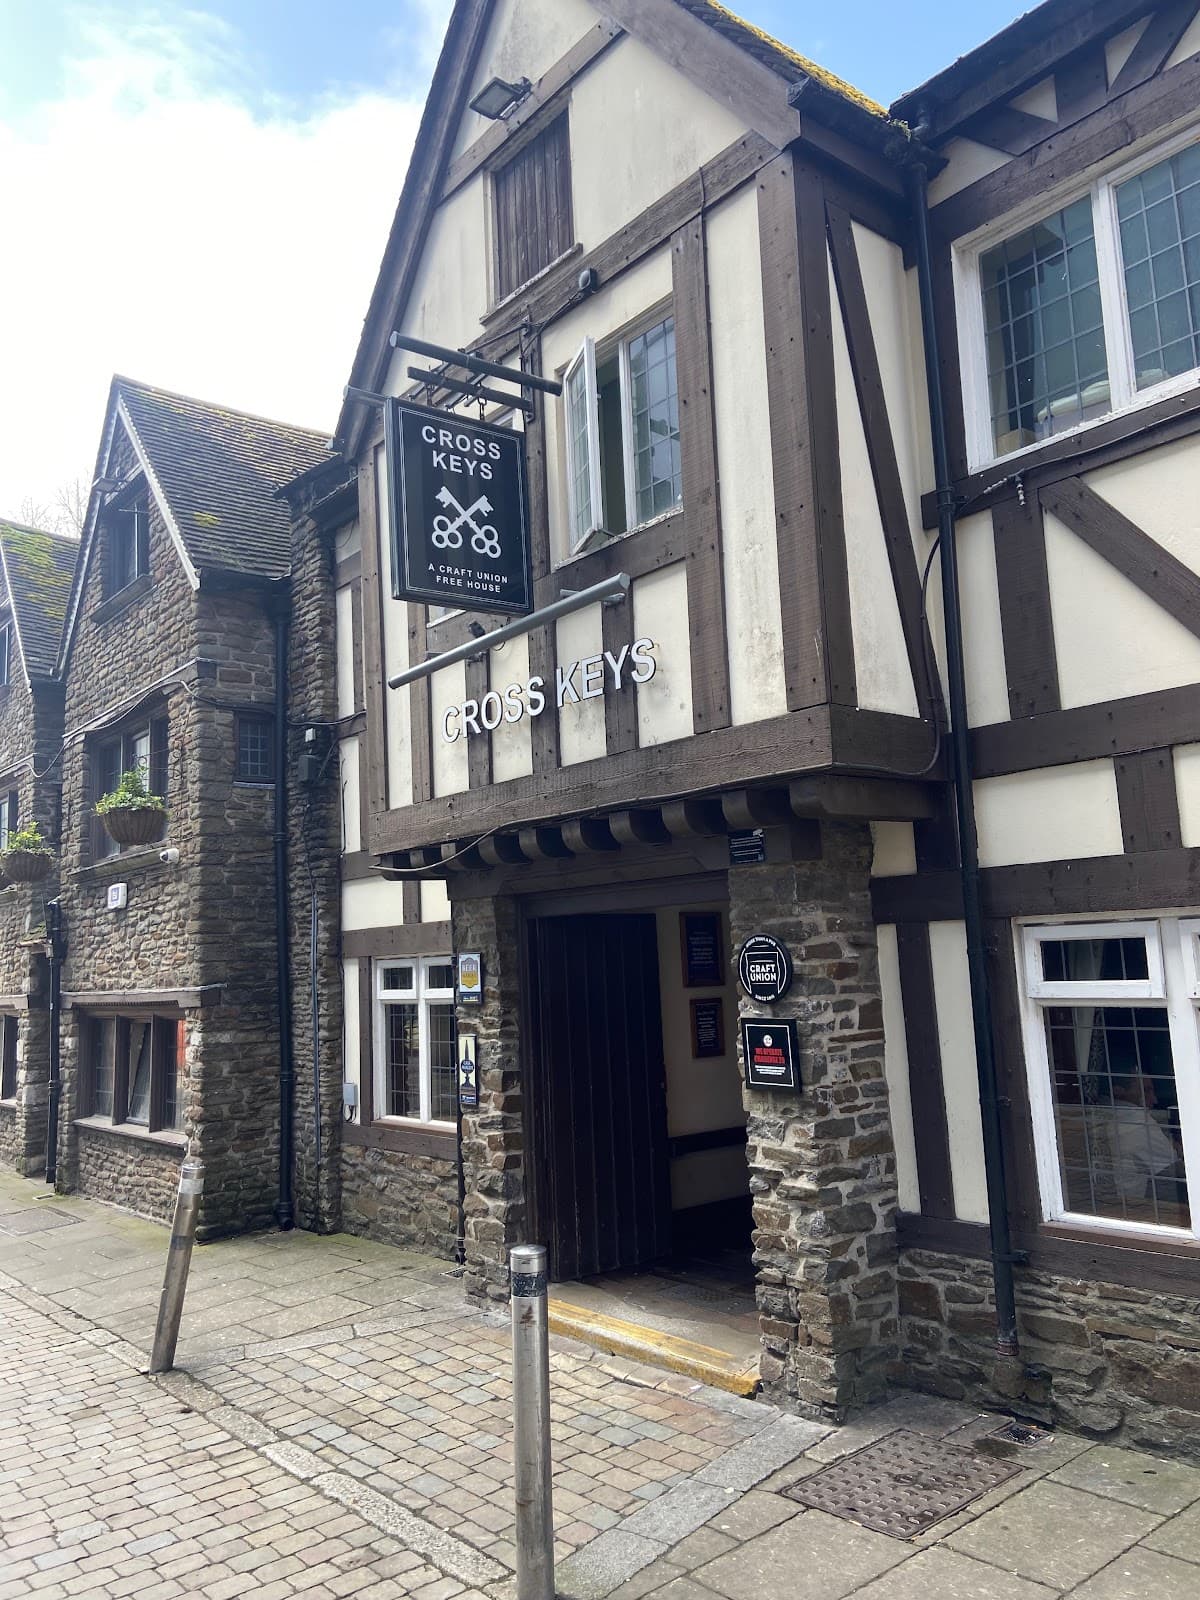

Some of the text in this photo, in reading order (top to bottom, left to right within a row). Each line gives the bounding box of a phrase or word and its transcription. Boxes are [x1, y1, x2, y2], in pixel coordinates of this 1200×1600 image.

[421, 425, 502, 460] CROSS
[432, 449, 493, 480] KEYS
[428, 563, 508, 584] A CRAFT UNION
[436, 575, 501, 593] FREE HOUSE
[441, 637, 657, 743] CROSS KEYS
[750, 964, 776, 973] CRAFT
[750, 972, 777, 982] UNION
